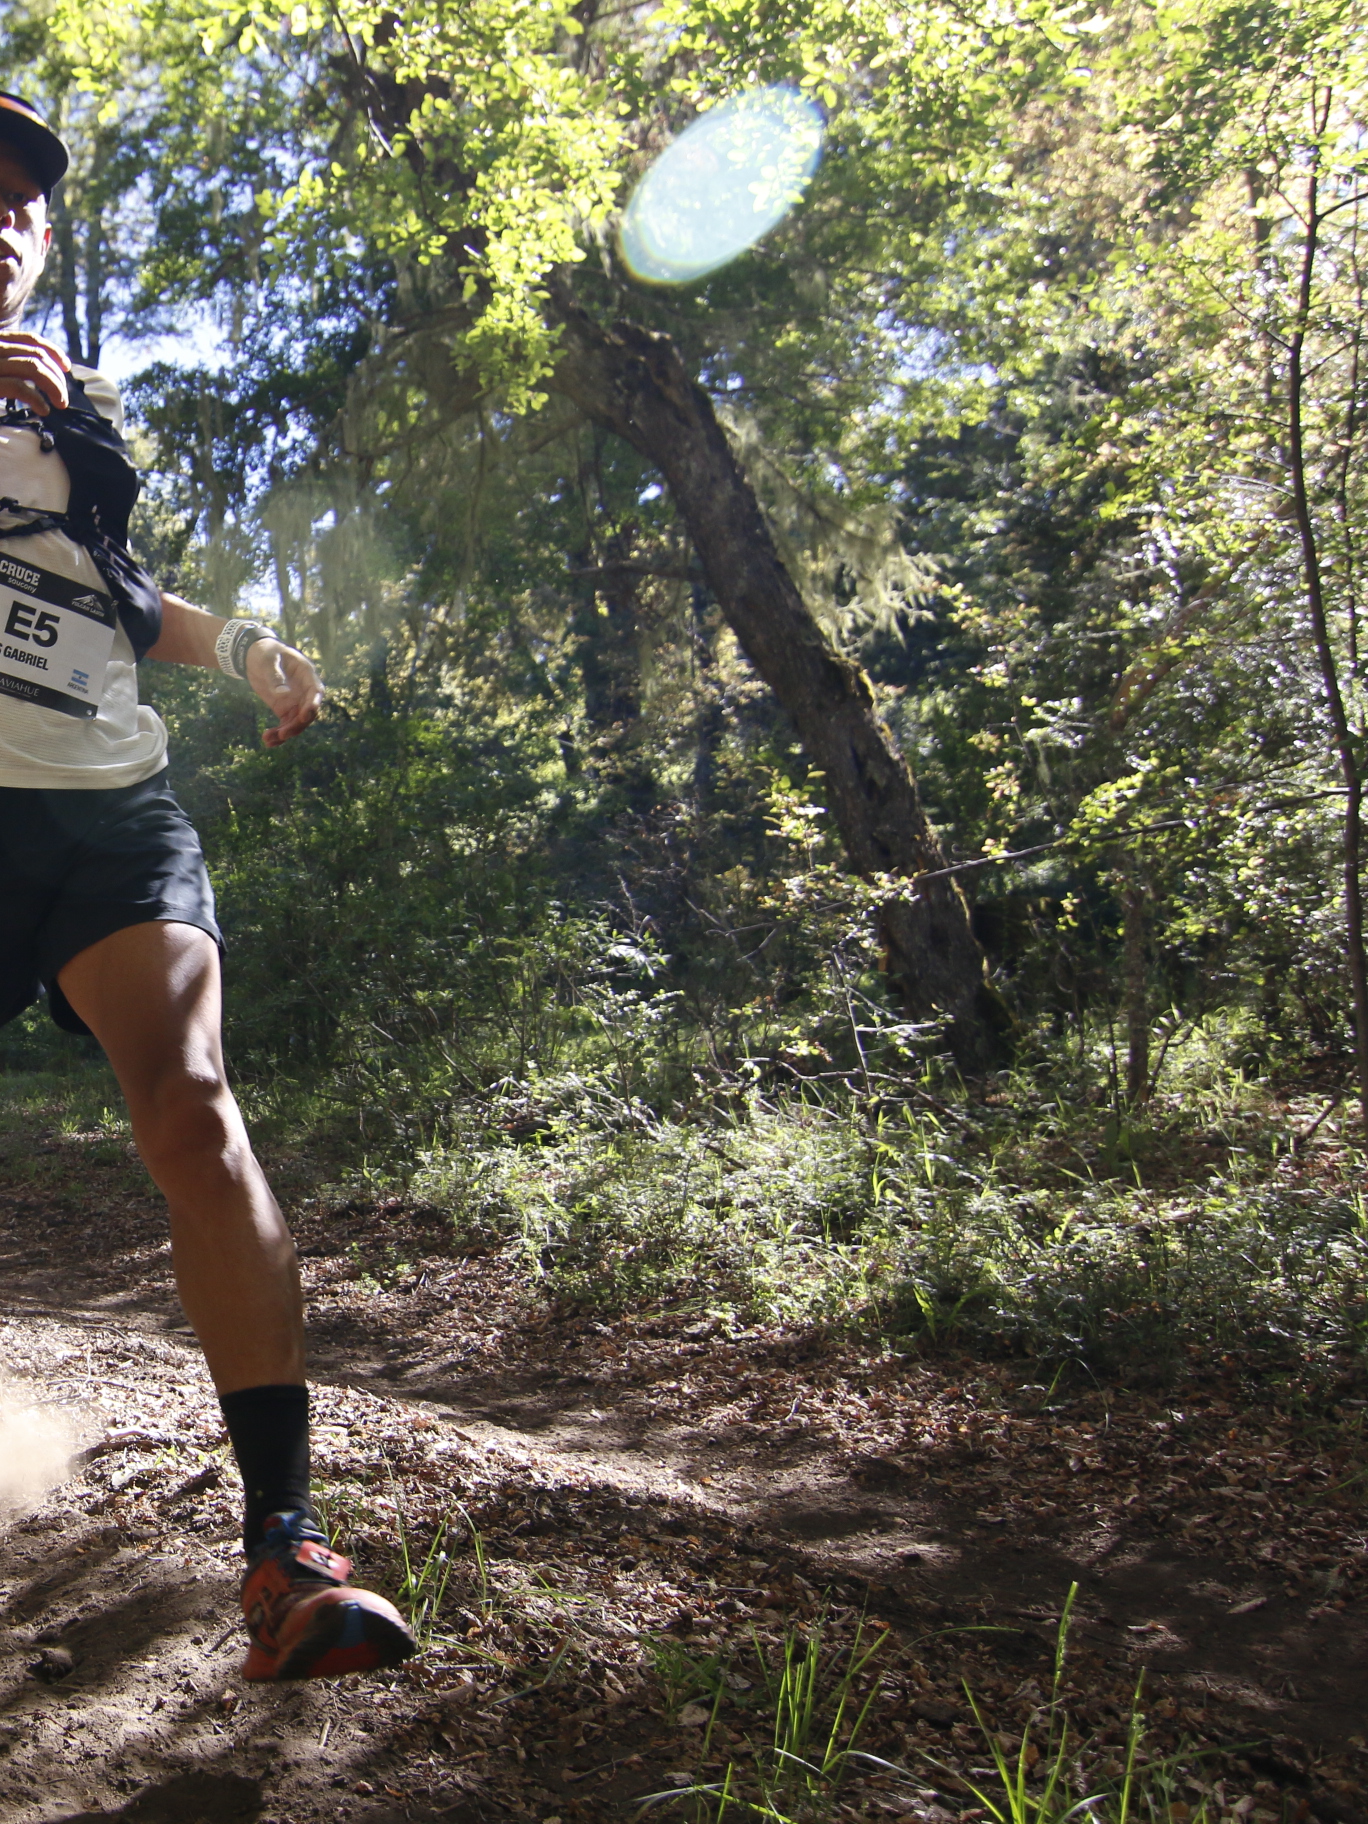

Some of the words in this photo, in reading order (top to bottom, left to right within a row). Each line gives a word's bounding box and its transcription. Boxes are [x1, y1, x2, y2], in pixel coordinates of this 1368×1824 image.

[8, 577, 37, 593] saucony
[4, 600, 61, 648] E5
[3, 645, 49, 671] GABRIEL
